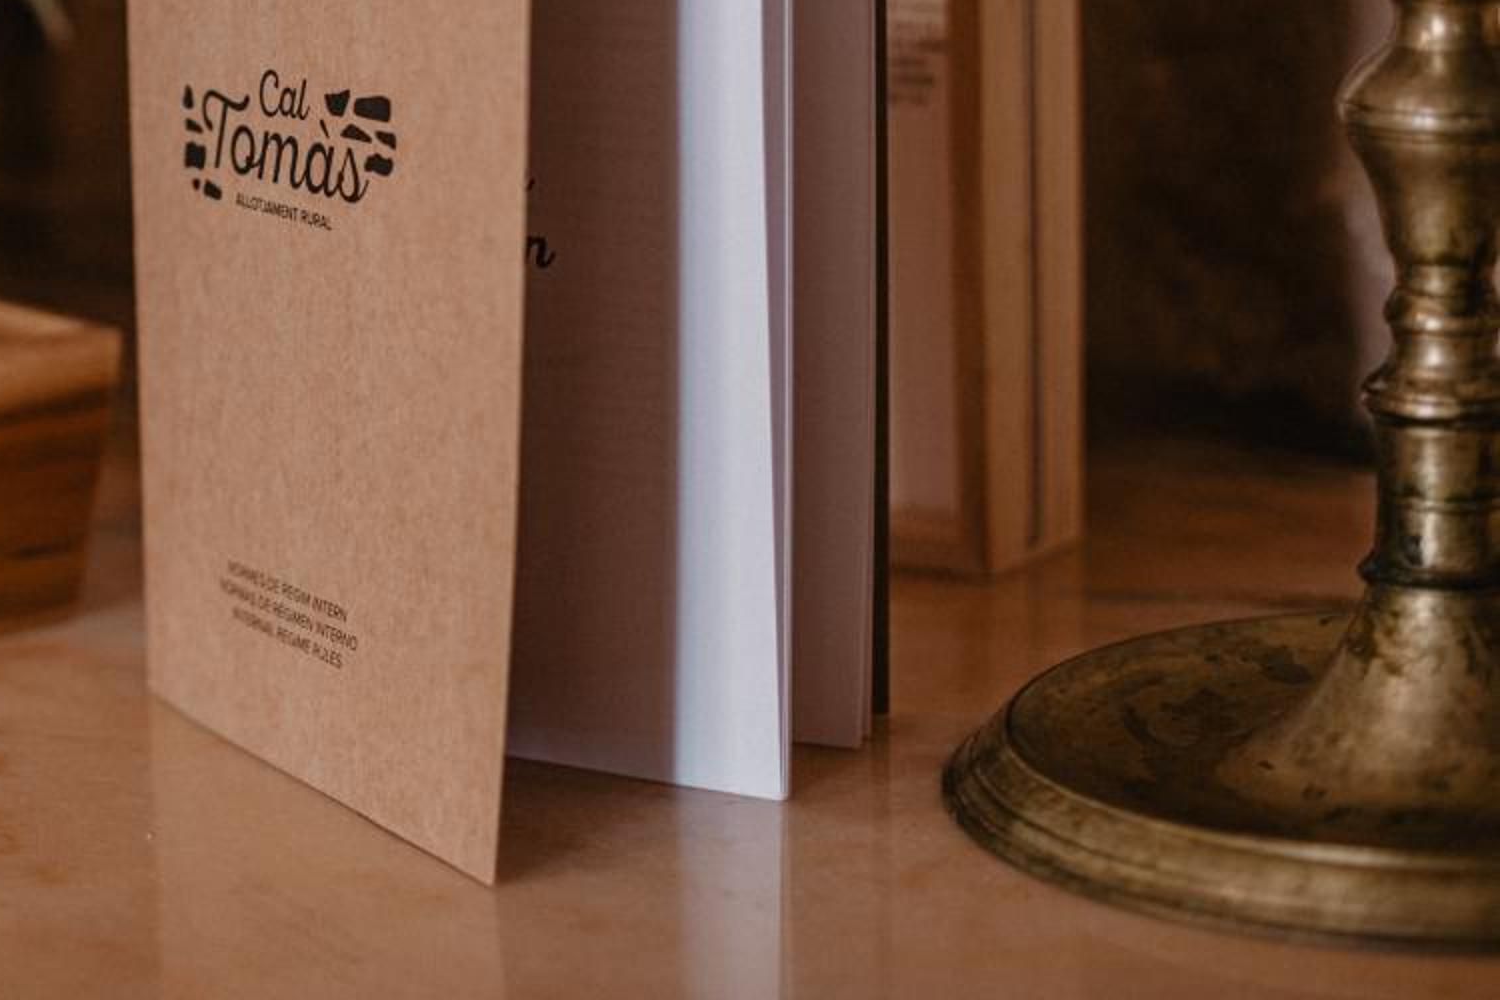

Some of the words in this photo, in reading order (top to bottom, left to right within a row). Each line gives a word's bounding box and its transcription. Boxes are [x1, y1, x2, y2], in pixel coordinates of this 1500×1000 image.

[259, 69, 311, 120] Cal
[202, 89, 369, 203] Tomàs
[314, 621, 358, 651] INTERNO
